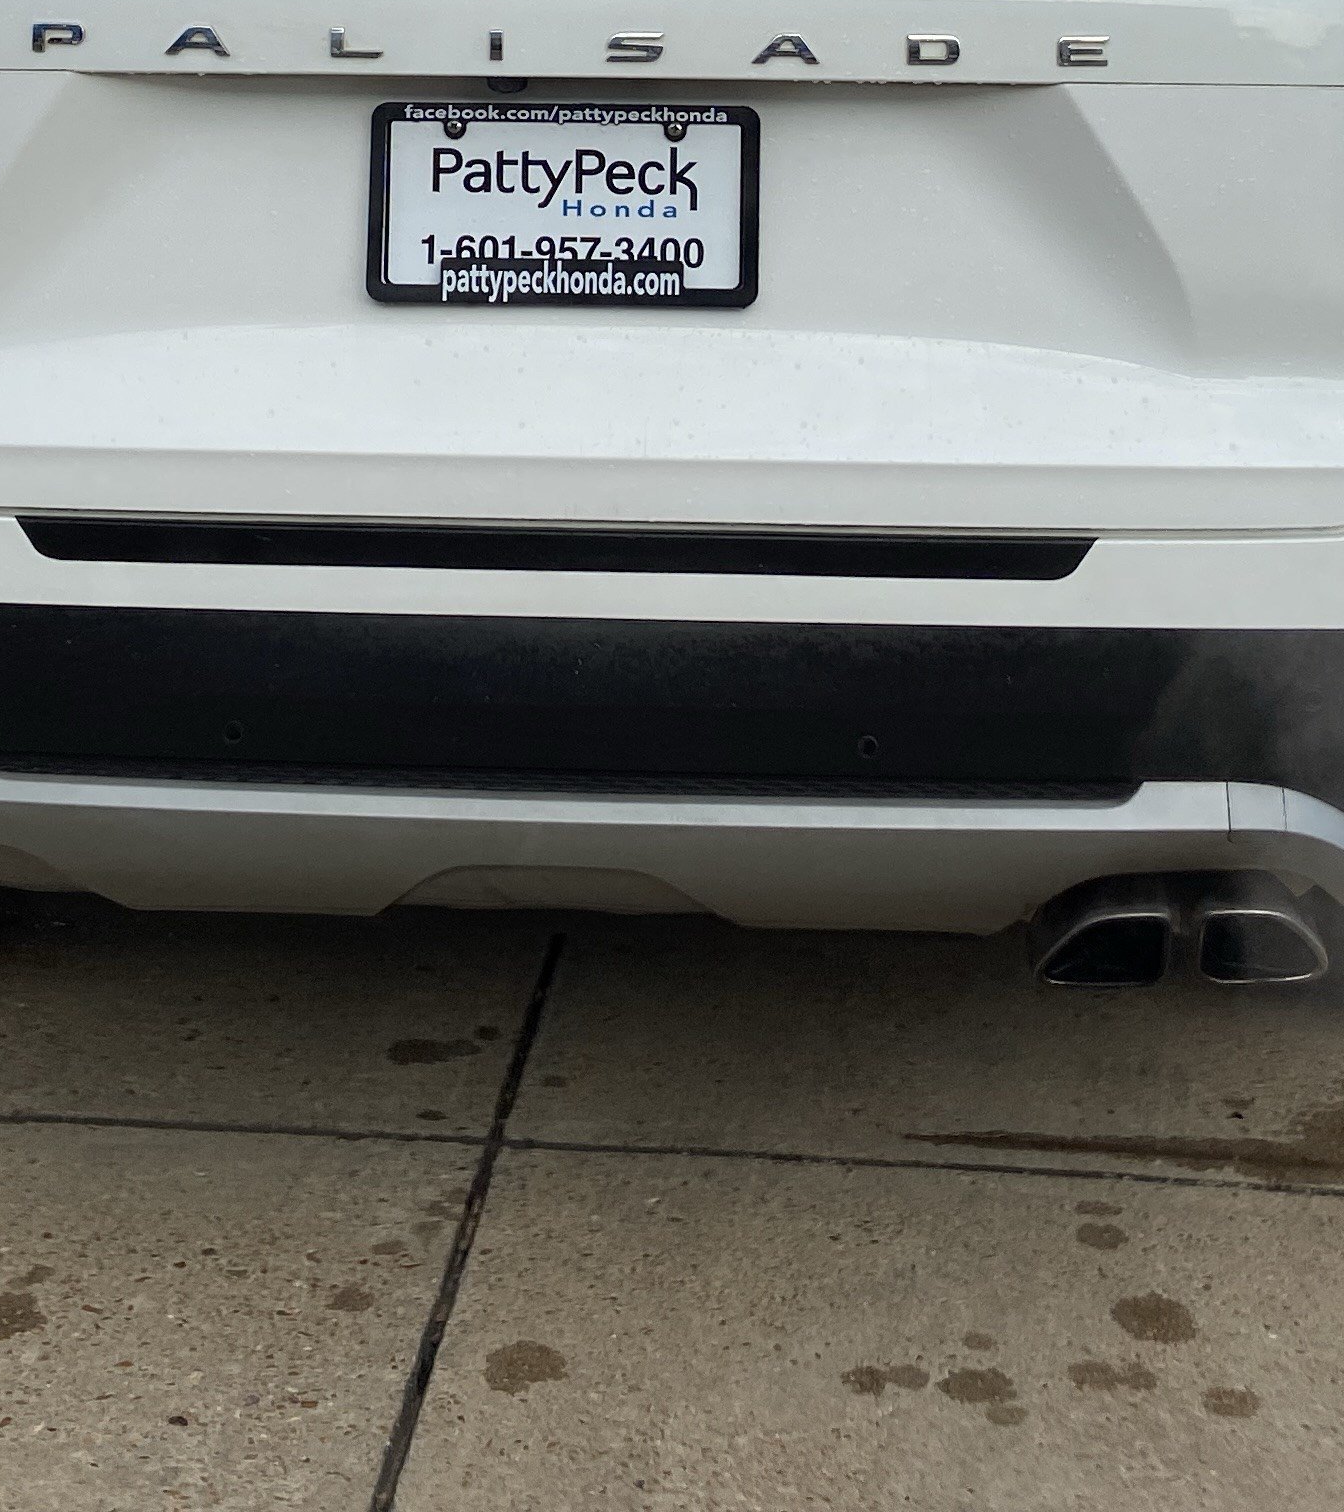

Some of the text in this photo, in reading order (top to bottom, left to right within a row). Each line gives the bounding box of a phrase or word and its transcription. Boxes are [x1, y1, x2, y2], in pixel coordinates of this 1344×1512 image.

[31, 22, 1111, 67] PALISADE
[404, 104, 728, 125] facebook.com/pattypeckhonda
[432, 146, 699, 211] PattyPeck
[562, 199, 678, 219] Honda
[441, 261, 680, 302] pattypeckhonda.com
